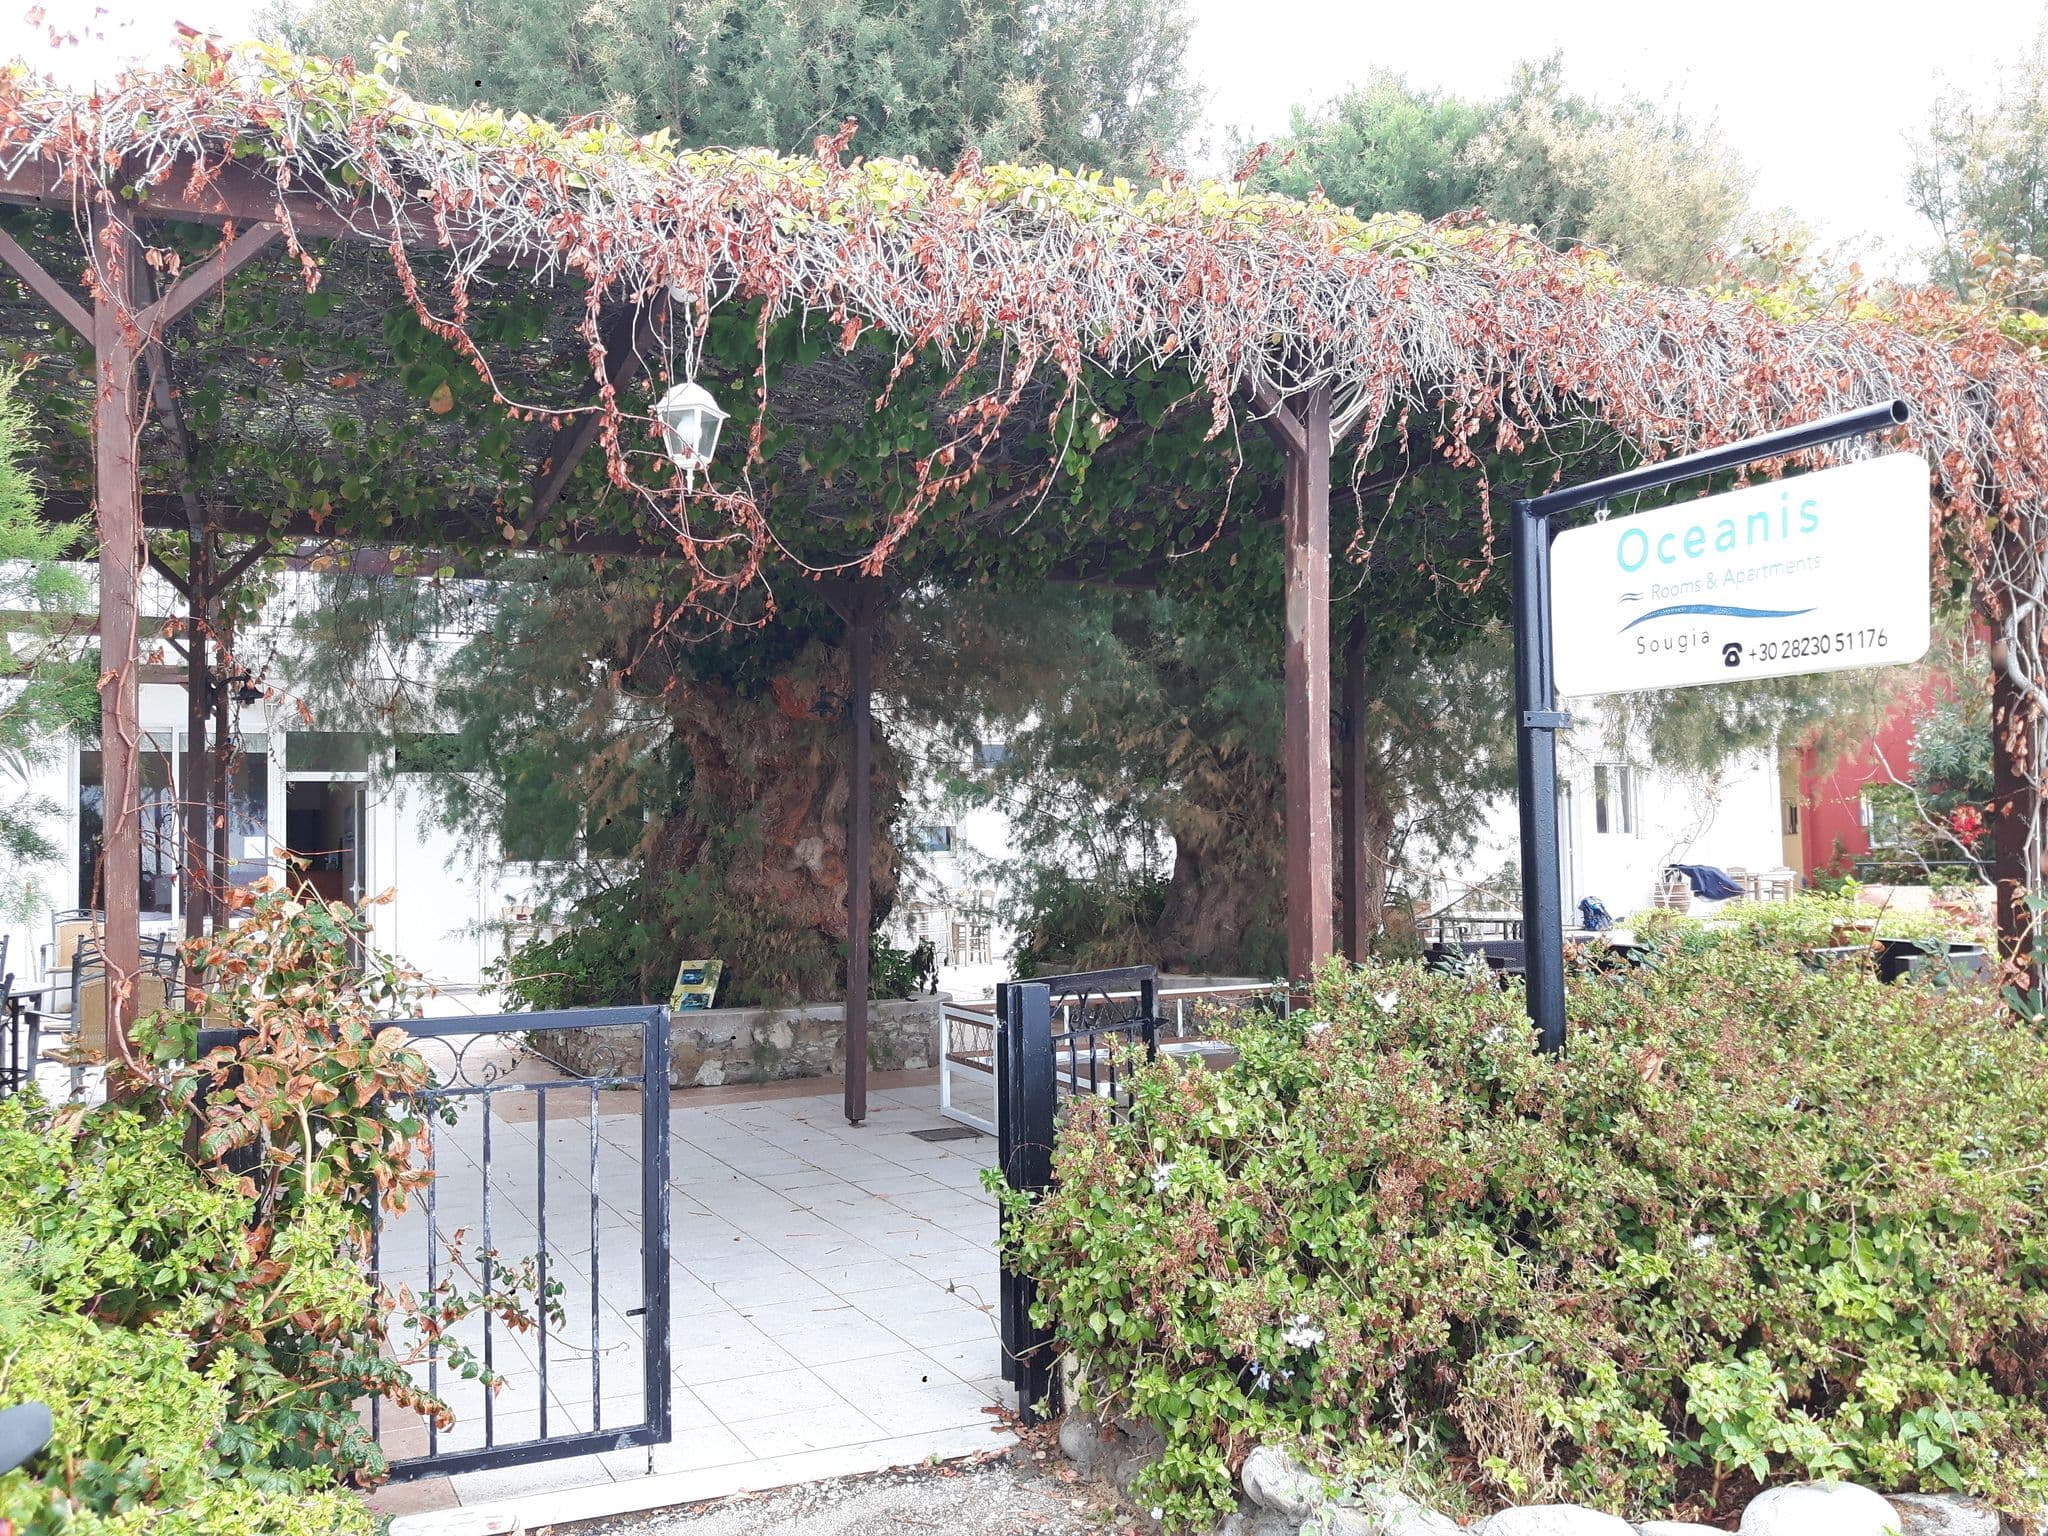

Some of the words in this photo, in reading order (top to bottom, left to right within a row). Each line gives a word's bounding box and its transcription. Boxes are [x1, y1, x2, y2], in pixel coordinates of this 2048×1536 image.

[1616, 491, 1819, 573] Oceanis
[1651, 580, 1702, 601] Rooms
[1706, 572, 1719, 590] &
[1723, 555, 1822, 590] Apartments
[1637, 628, 1711, 655] Sougia
[1748, 641, 1778, 662] +30
[1781, 634, 1831, 660] 28230
